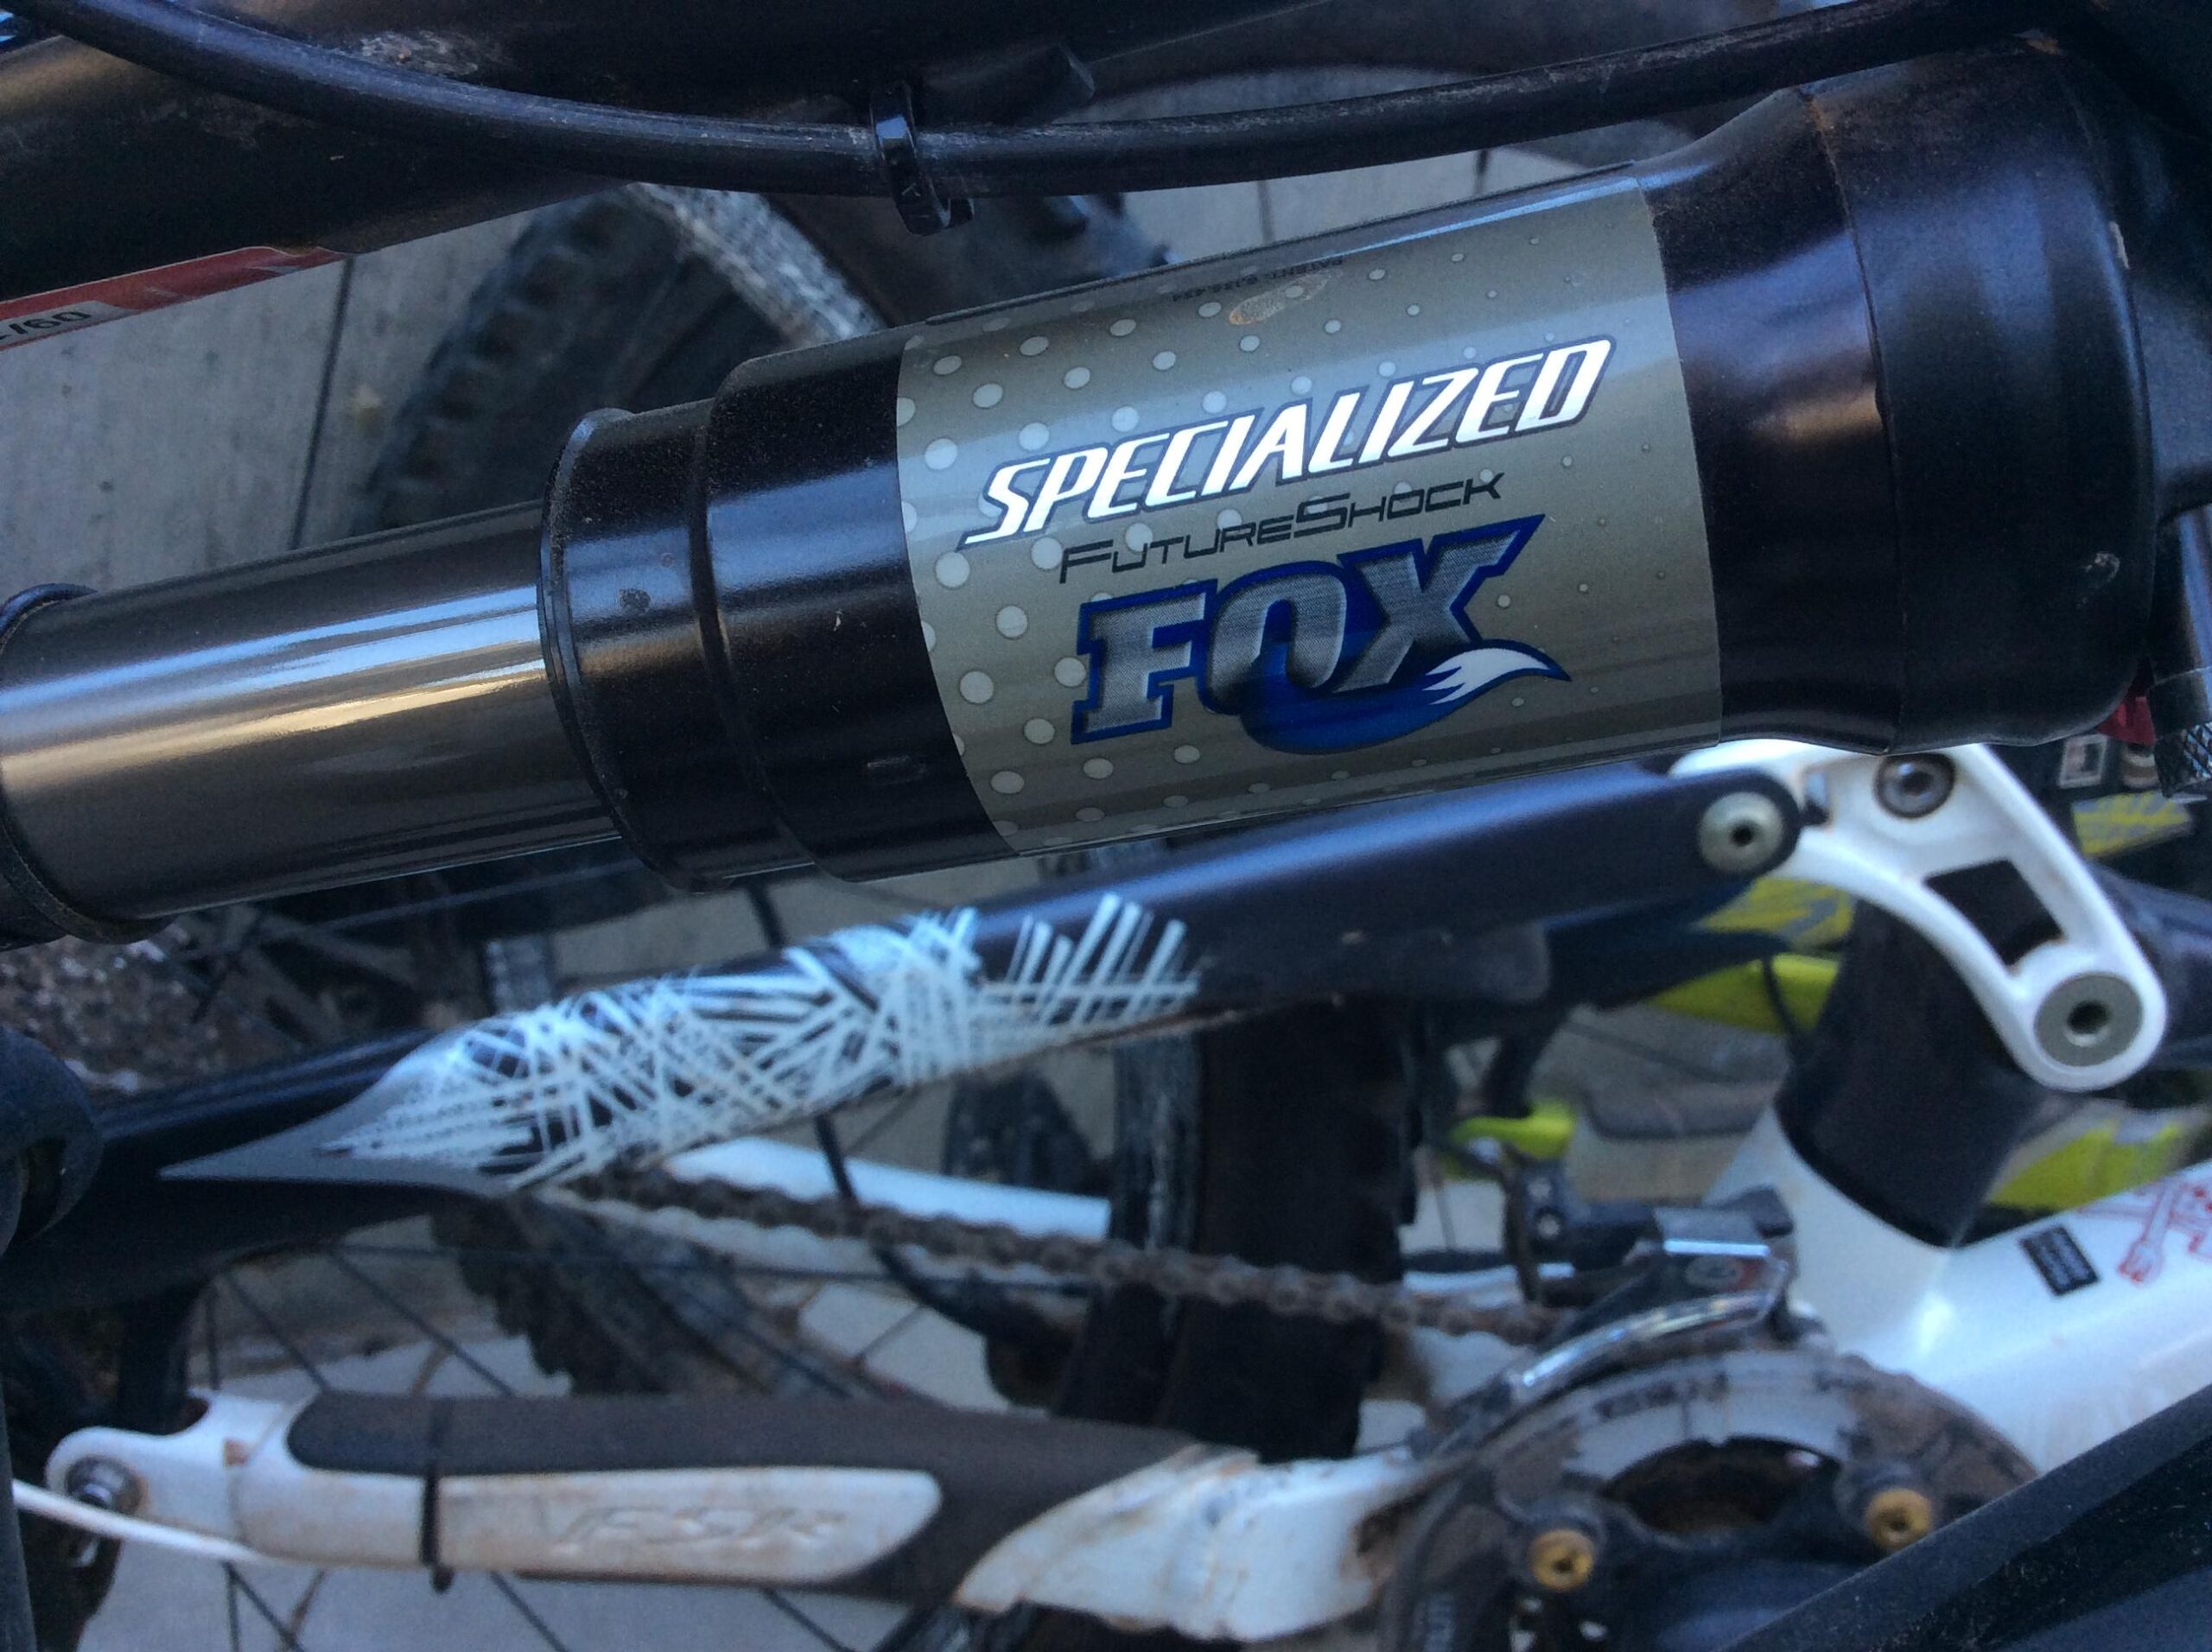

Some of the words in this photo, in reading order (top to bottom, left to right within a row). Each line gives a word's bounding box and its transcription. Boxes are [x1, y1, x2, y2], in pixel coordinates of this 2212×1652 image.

[961, 338, 1613, 548] SPECIALIZED
[1059, 472, 1505, 584] FUTURESHOCK
[1071, 514, 1571, 754] FOX
